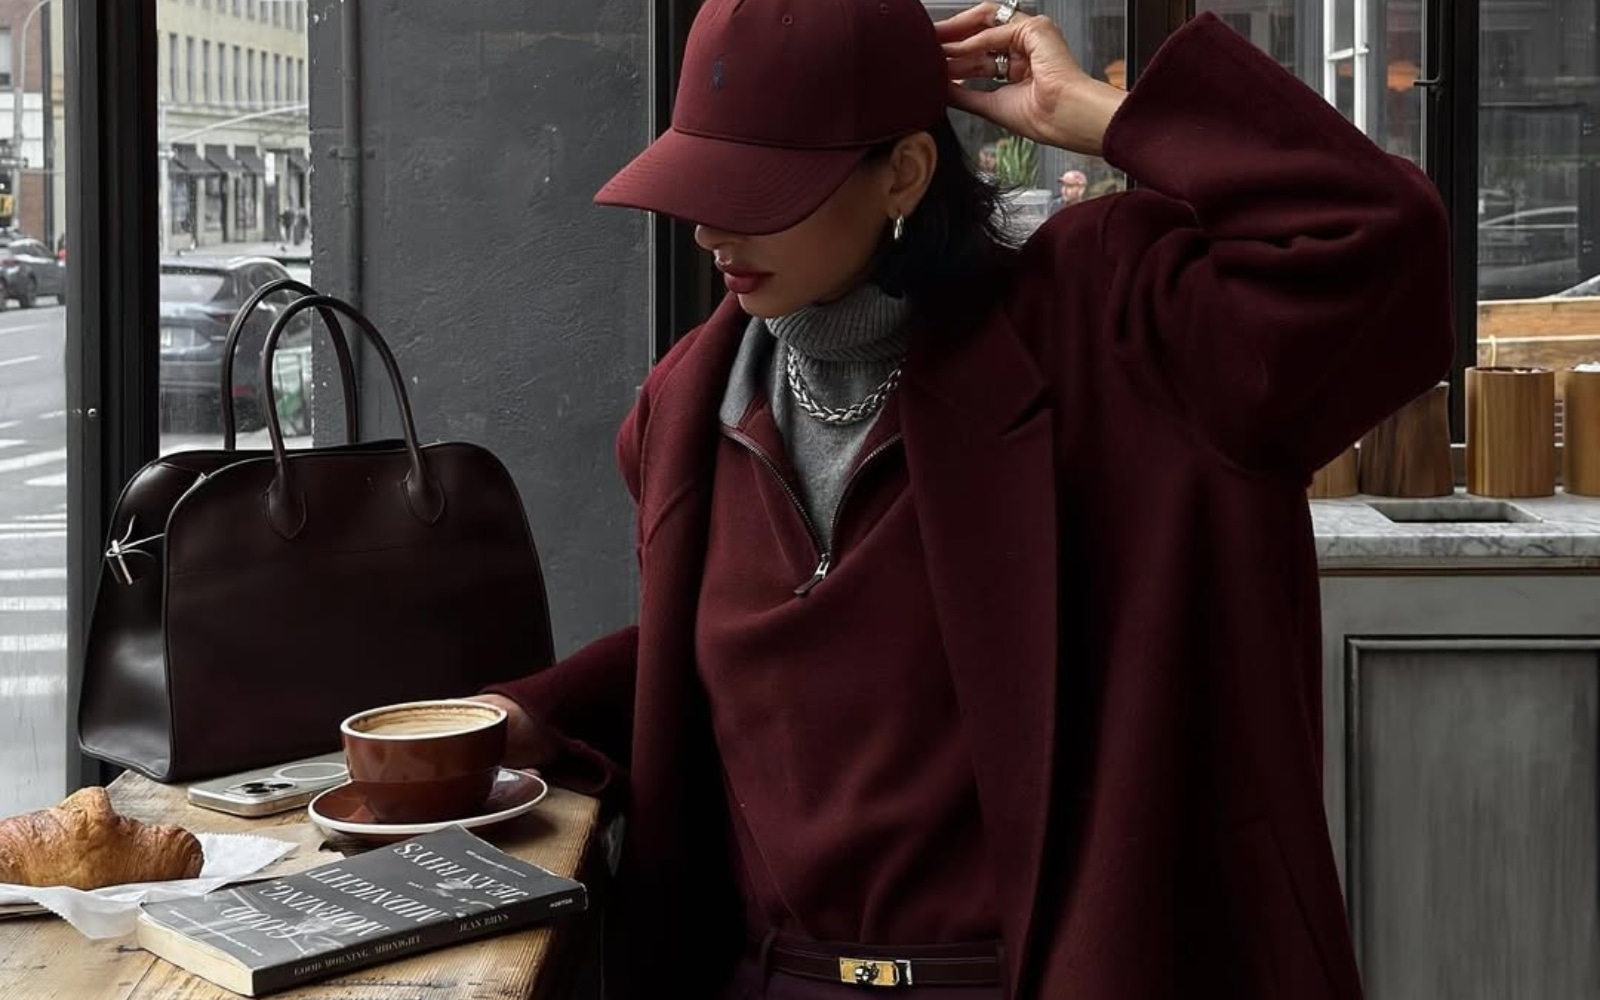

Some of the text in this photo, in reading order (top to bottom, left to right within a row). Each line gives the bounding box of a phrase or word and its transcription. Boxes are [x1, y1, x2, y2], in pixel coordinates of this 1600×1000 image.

[393, 843, 467, 877] RHYS
[305, 868, 449, 922] MIDNIGHT
[454, 873, 529, 899] JEAN
[220, 906, 302, 938] GOOD
